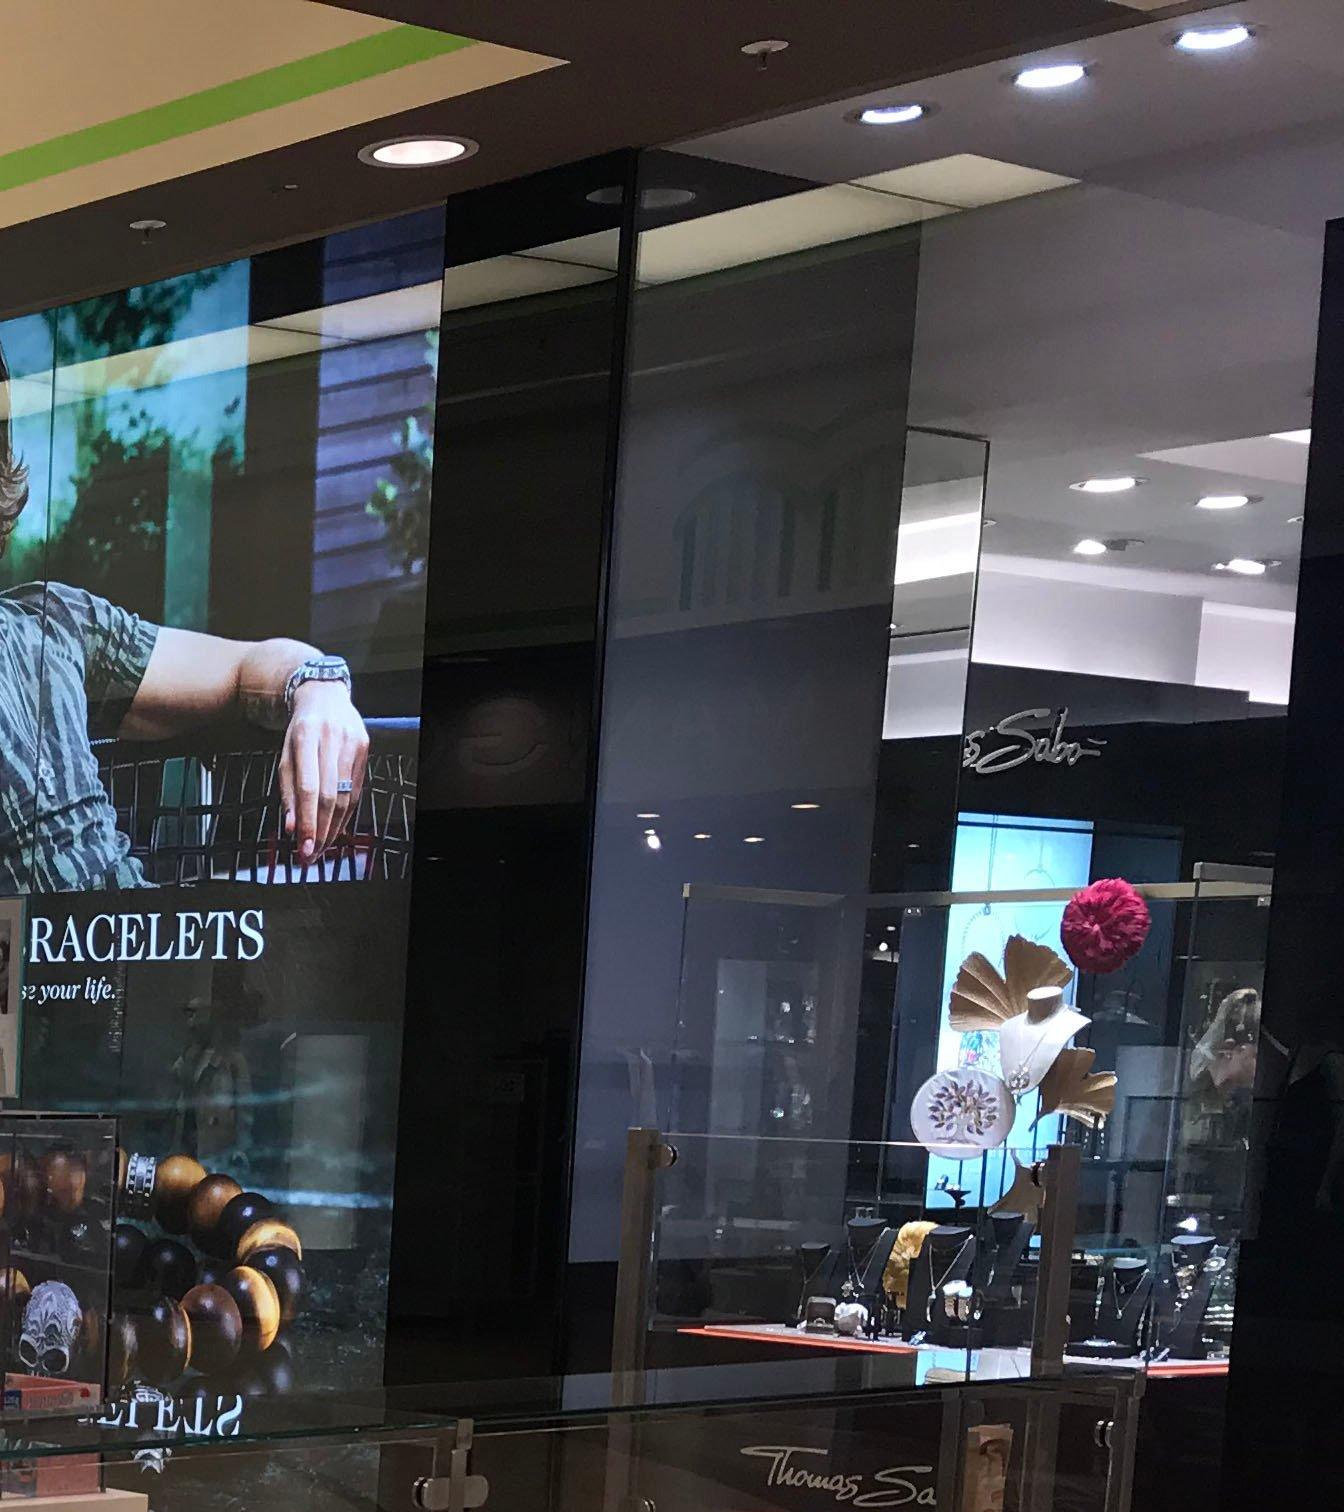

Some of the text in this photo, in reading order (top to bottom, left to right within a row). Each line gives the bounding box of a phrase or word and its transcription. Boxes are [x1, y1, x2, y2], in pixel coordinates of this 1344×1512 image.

[976, 697, 1108, 775] Sabo
[24, 909, 265, 964] RACELETS
[38, 982, 81, 1006] your
[83, 976, 117, 1002] life.
[740, 1445, 937, 1508] Thomas Sa
